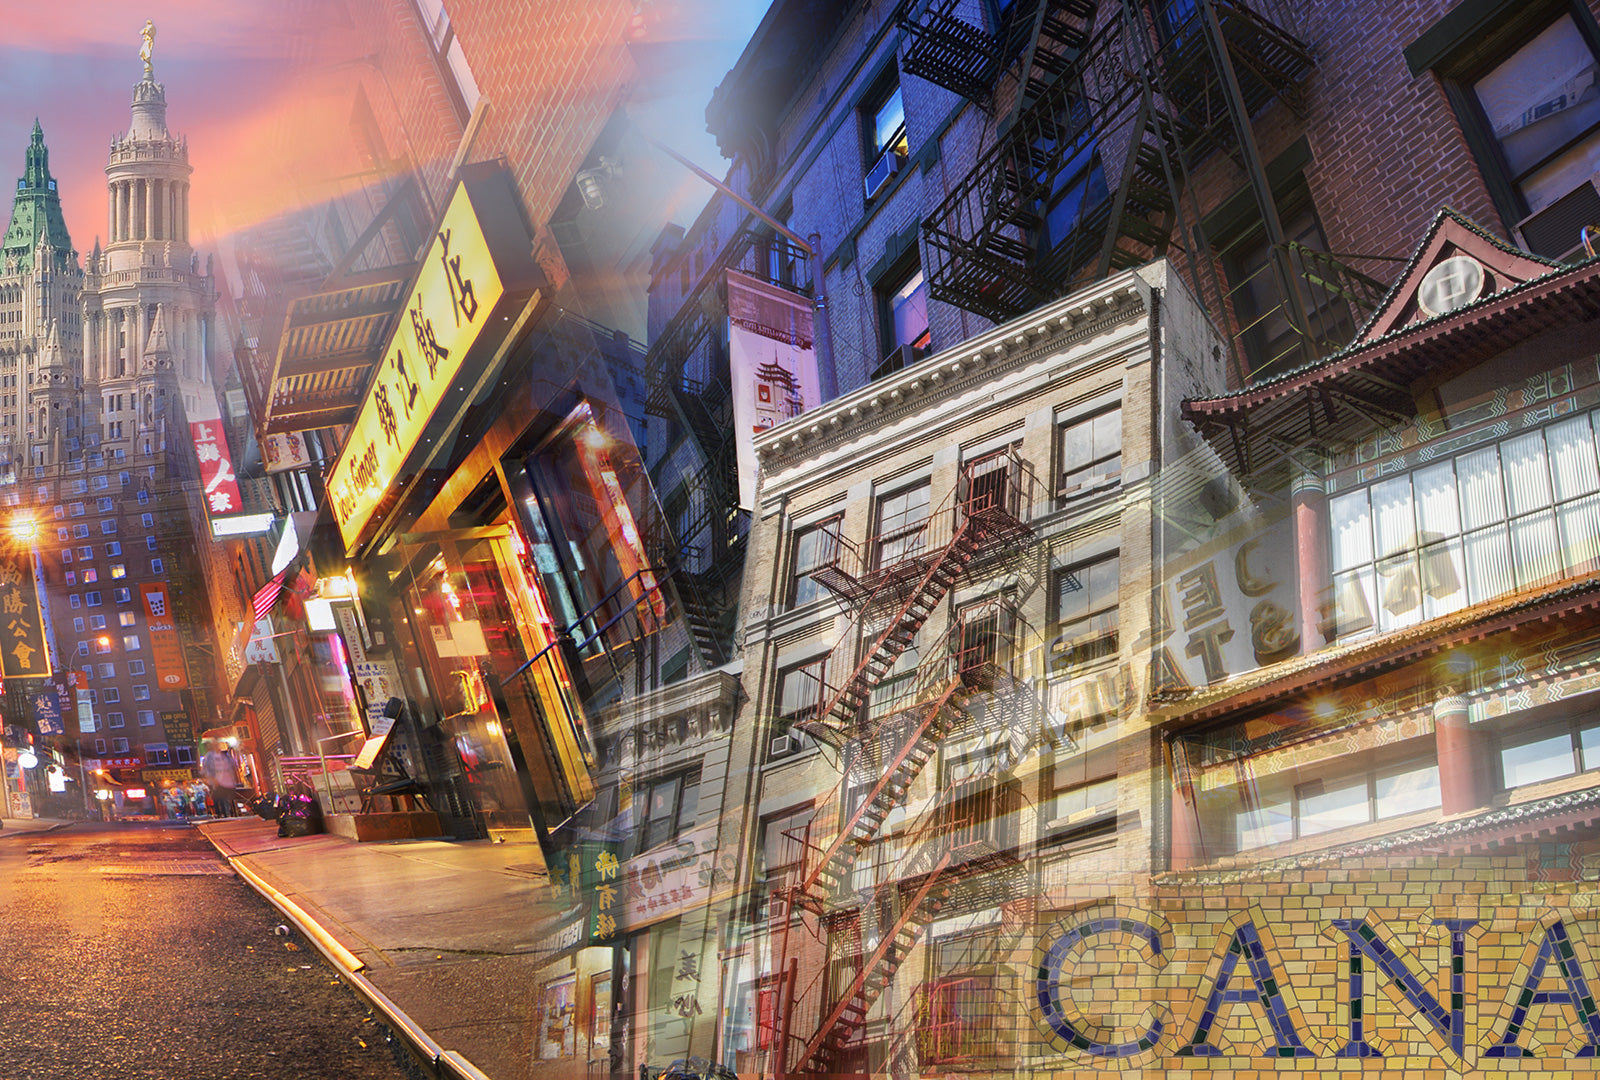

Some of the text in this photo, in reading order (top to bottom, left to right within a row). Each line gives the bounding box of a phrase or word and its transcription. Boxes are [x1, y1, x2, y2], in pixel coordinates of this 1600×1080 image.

[374, 228, 479, 453] 錦江飯店
[194, 423, 236, 512] 上海人家
[349, 438, 381, 497] Ginger
